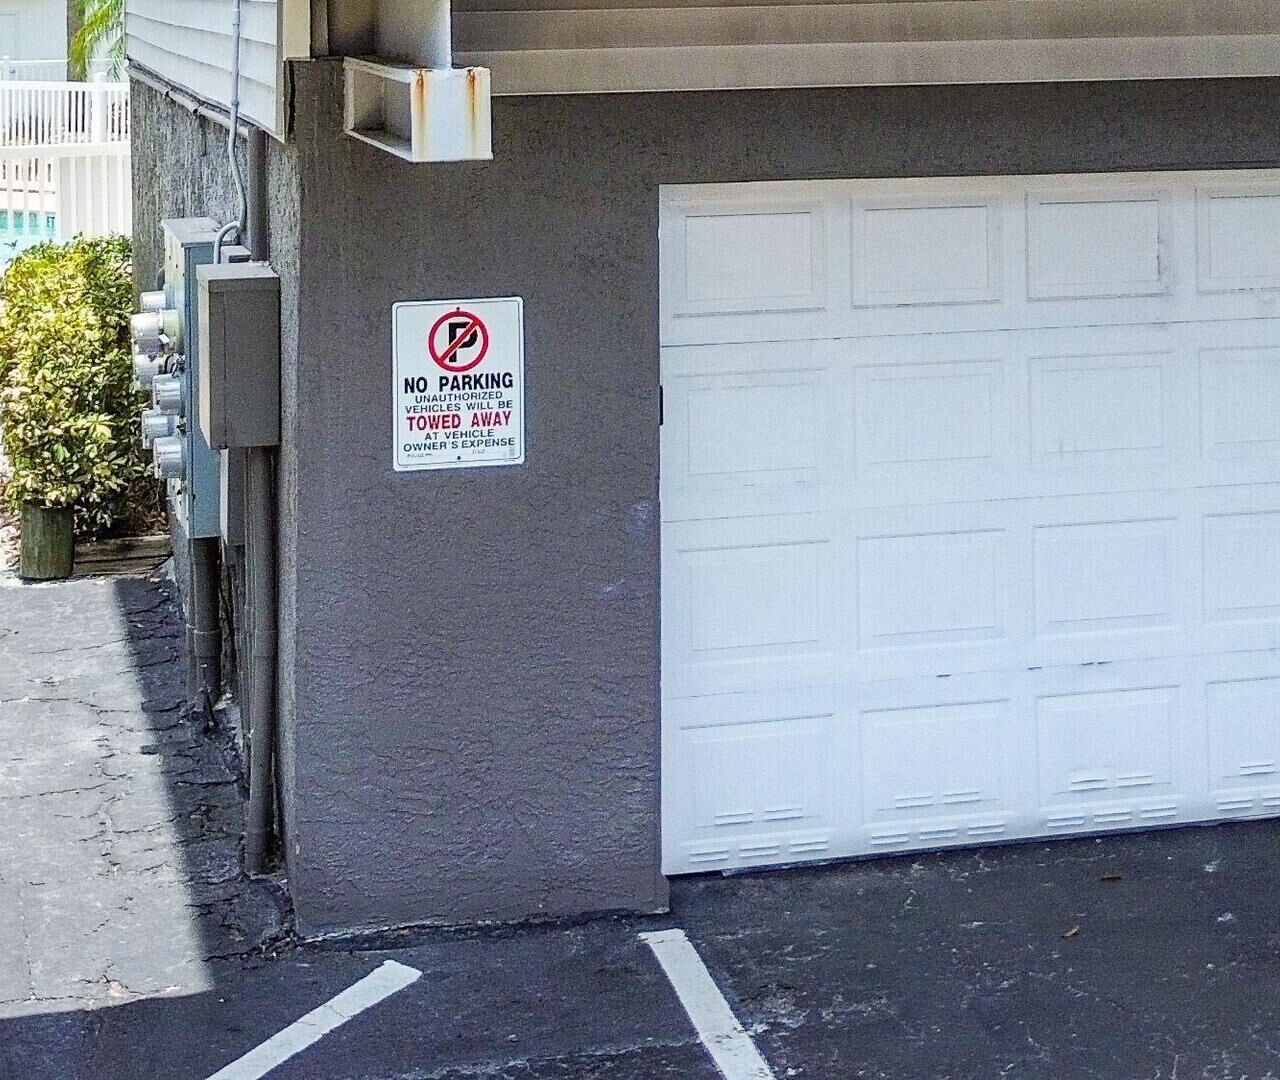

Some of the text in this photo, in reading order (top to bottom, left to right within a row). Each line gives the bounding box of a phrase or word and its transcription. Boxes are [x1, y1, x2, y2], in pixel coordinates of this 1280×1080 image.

[404, 372, 513, 394] NO PARKING
[415, 391, 503, 403] UNAUTHORIZED
[406, 400, 513, 414] VEHICLES WILL BE
[407, 411, 511, 432] TOWED AWAY
[425, 429, 495, 441] AT VEHICLE
[461, 438, 515, 449] EXPENSE
